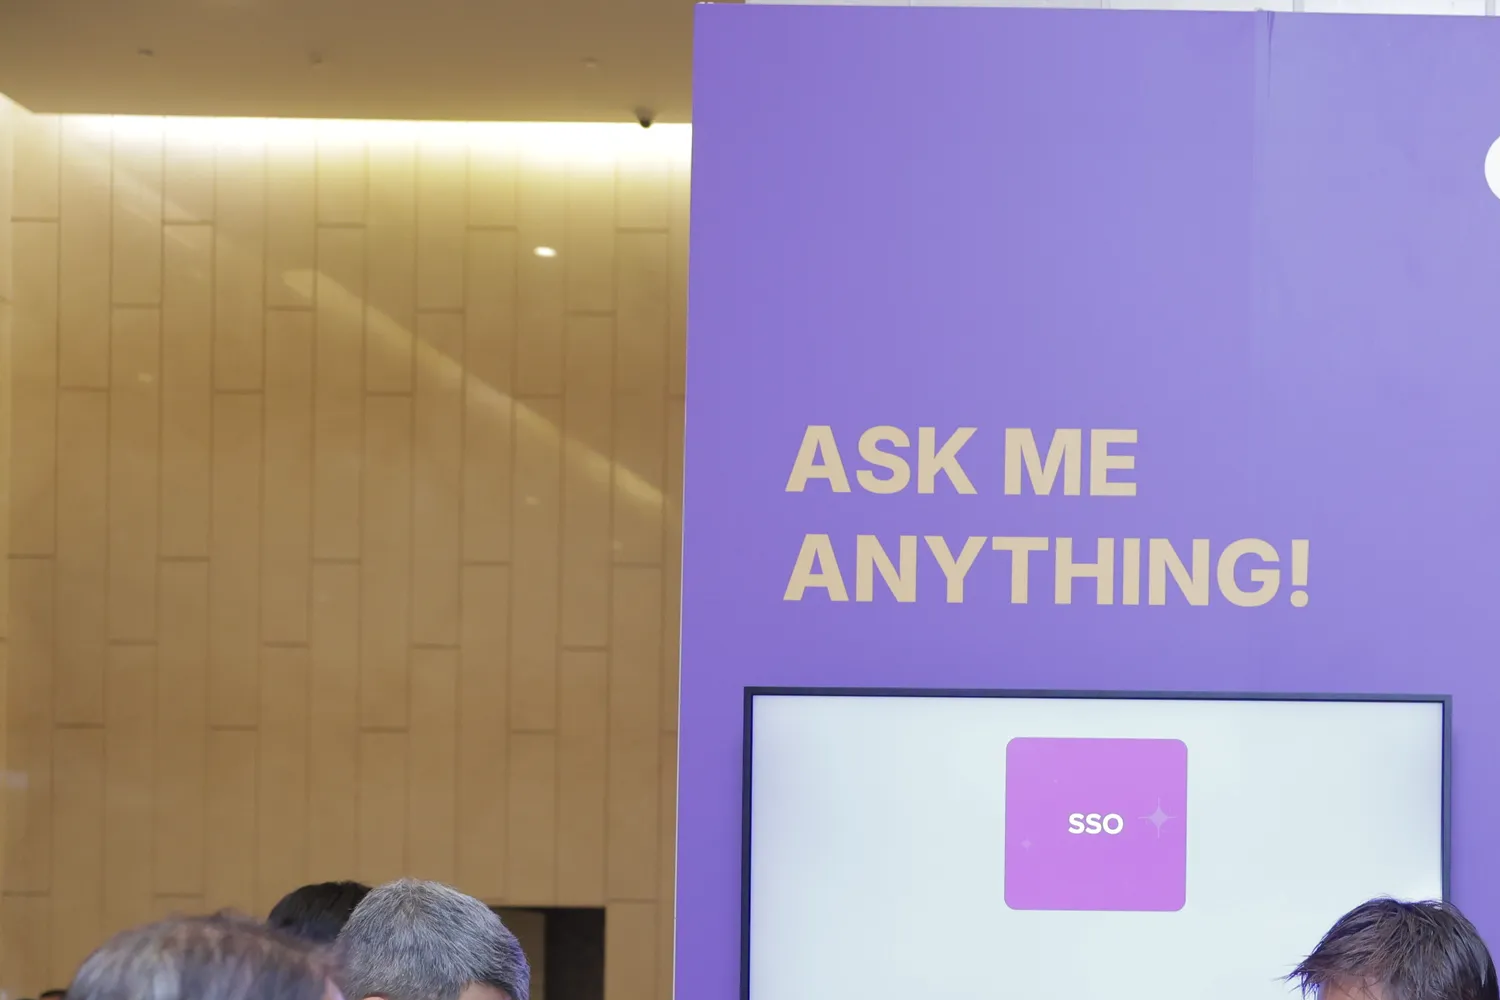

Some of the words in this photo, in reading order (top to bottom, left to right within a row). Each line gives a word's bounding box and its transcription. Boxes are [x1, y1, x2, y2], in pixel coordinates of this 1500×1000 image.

[784, 425, 979, 495] ASK
[1003, 428, 1138, 497] ME
[783, 533, 1310, 608] ANYTHING!
[1068, 813, 1124, 835] SSO
